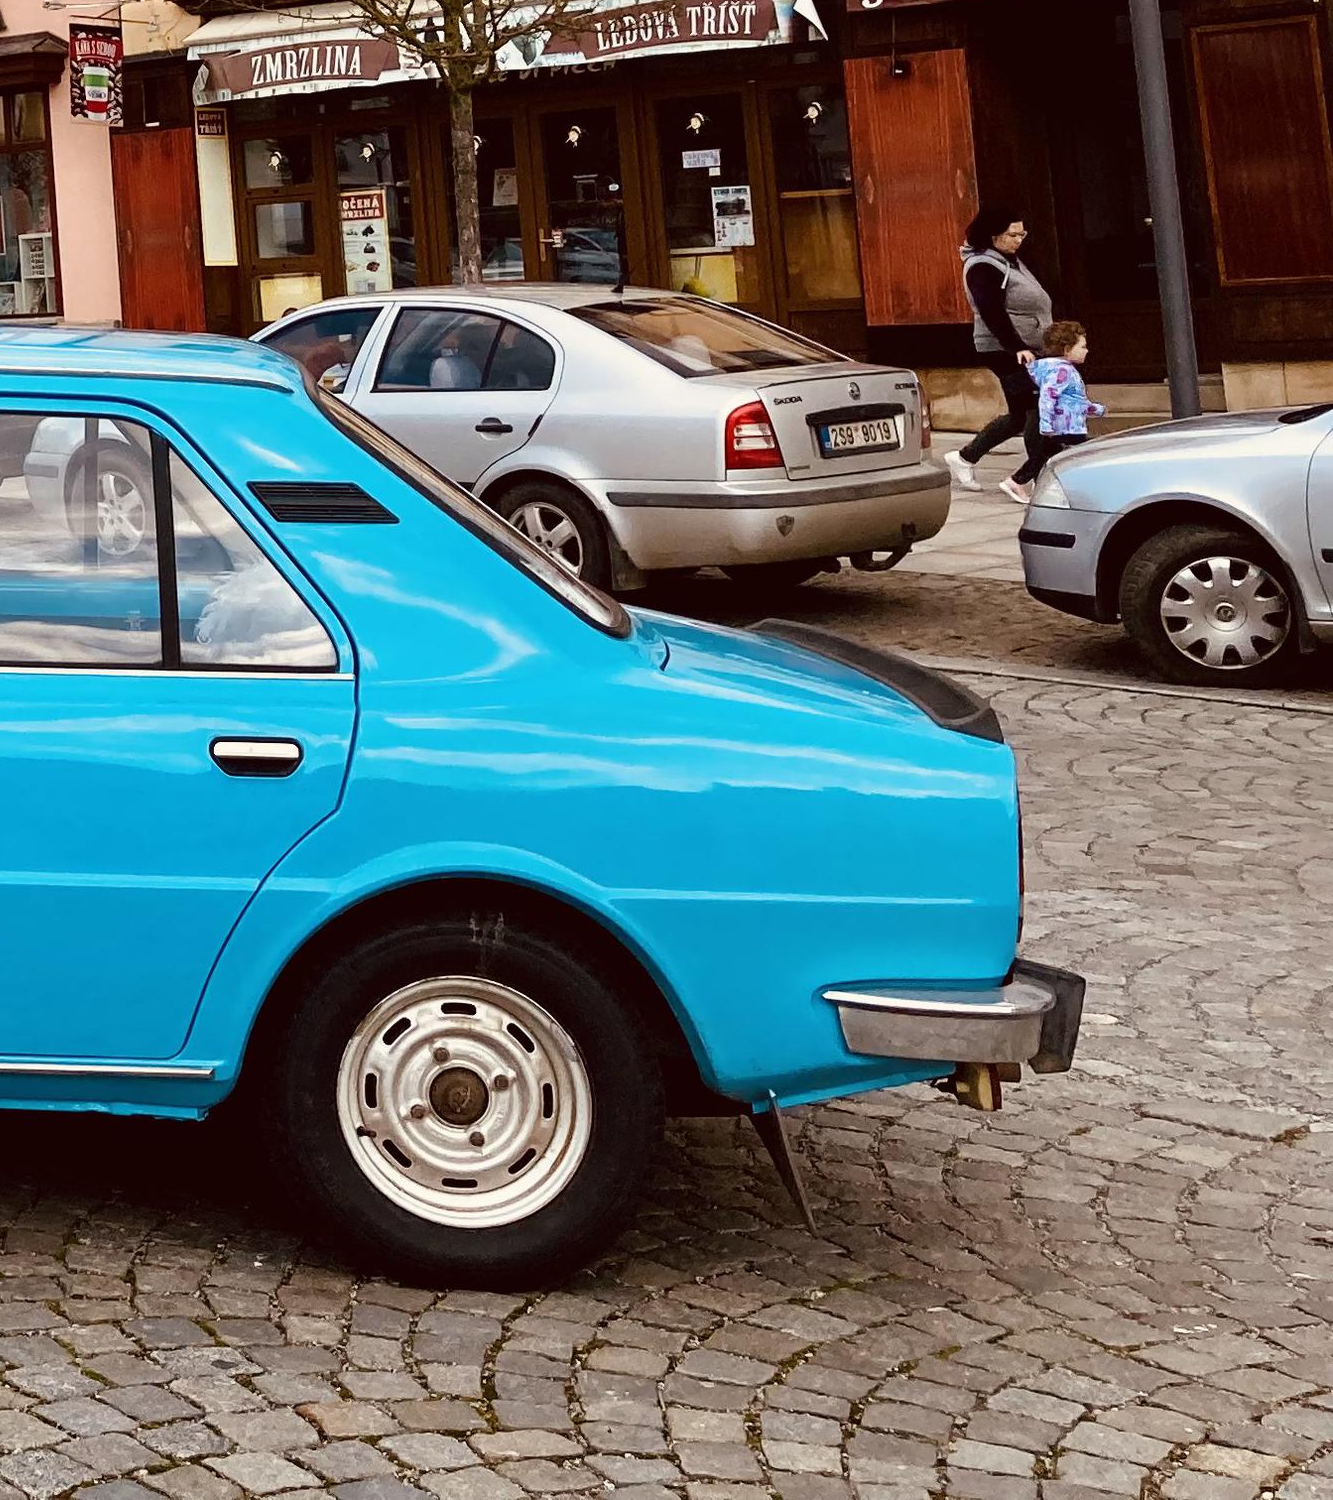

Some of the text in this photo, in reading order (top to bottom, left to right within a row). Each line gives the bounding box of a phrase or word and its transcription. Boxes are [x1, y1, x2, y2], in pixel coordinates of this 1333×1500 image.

[594, 0, 758, 52] LEDOVÁ TŘÍŠŤ
[251, 45, 362, 86] ZMRZLINA
[341, 209, 381, 219] MRZLINA
[342, 196, 380, 210] OČENÁ
[831, 421, 891, 448] 2S9 9019
